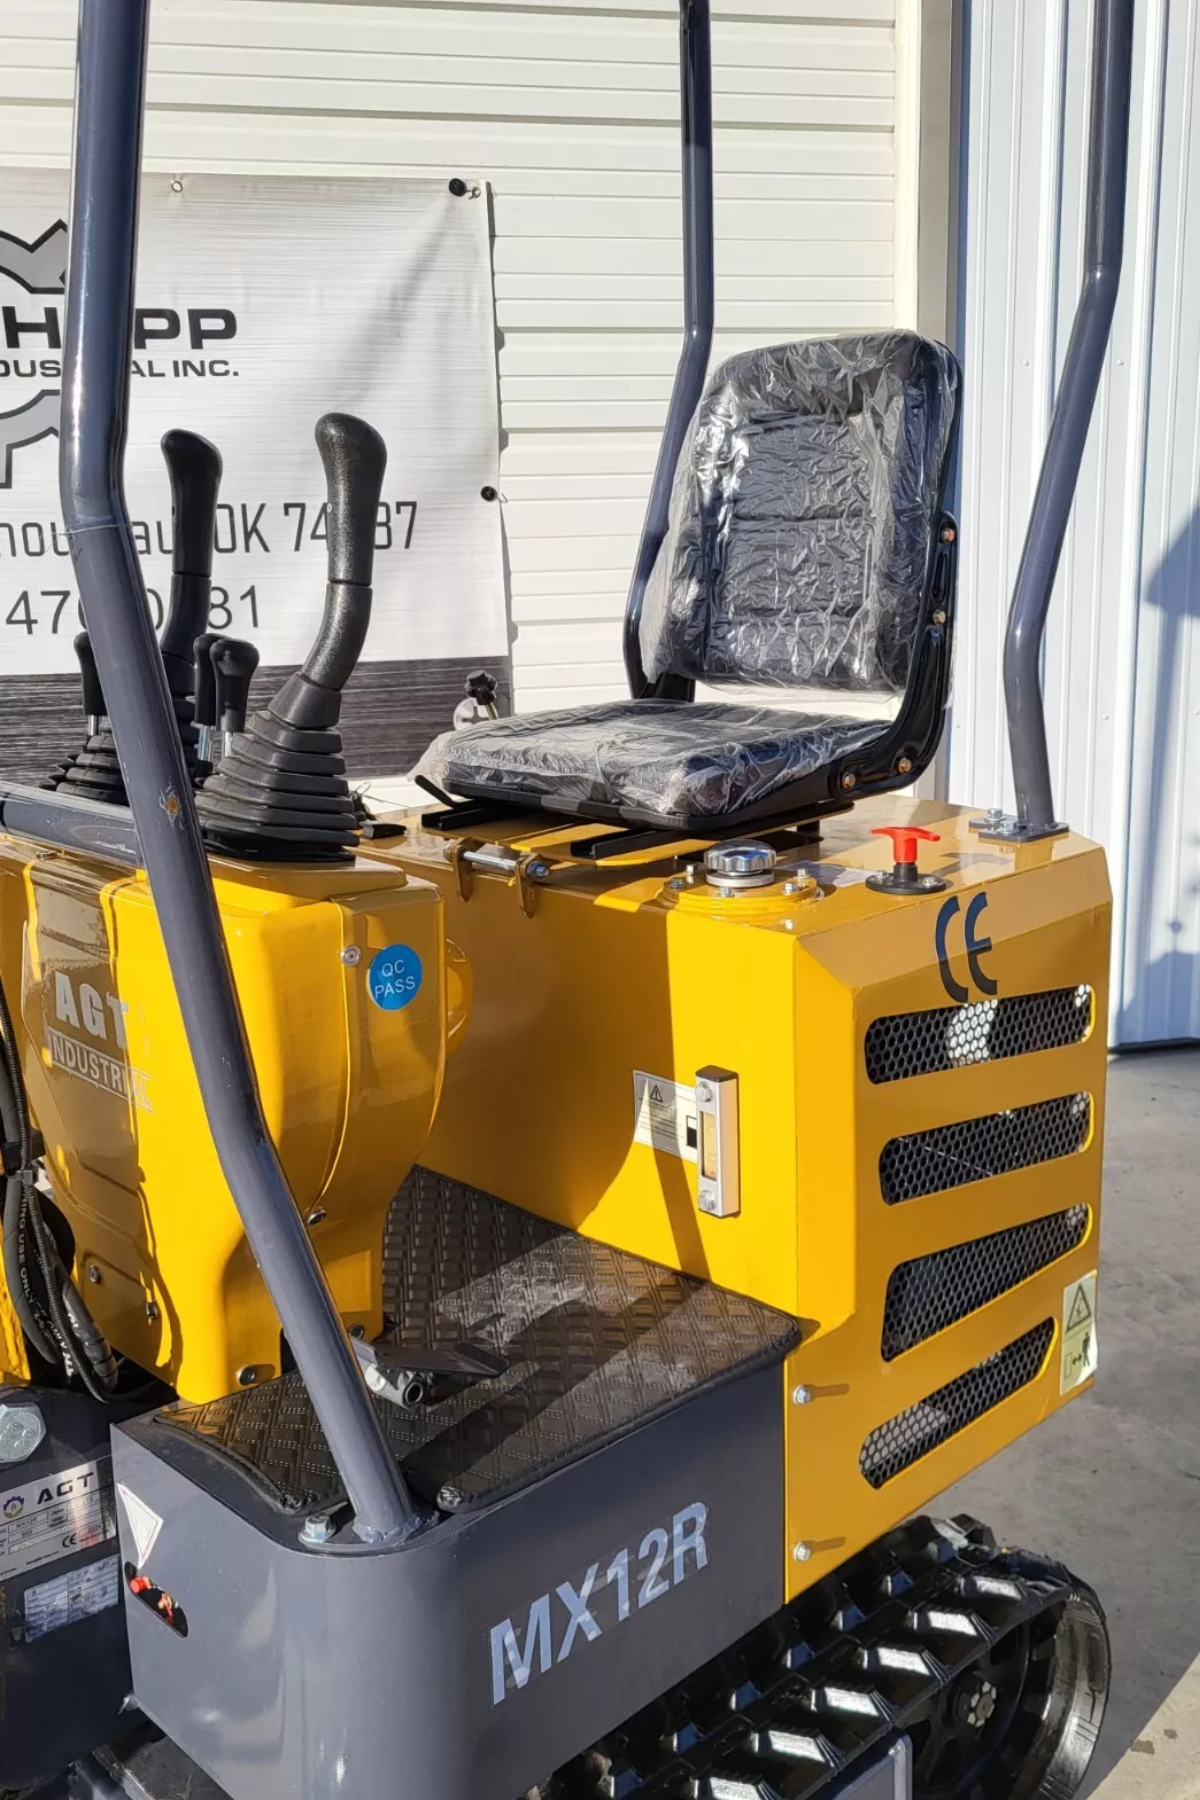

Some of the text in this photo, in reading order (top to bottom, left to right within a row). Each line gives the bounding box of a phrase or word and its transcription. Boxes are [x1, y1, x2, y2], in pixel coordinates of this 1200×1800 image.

[2, 306, 237, 350] HPP
[172, 359, 239, 377] INC.
[381, 959, 405, 977] QC
[374, 976, 416, 999] PASS
[54, 970, 129, 1051] AGT
[37, 1472, 94, 1505] AGT
[490, 1501, 708, 1707] MX12R
